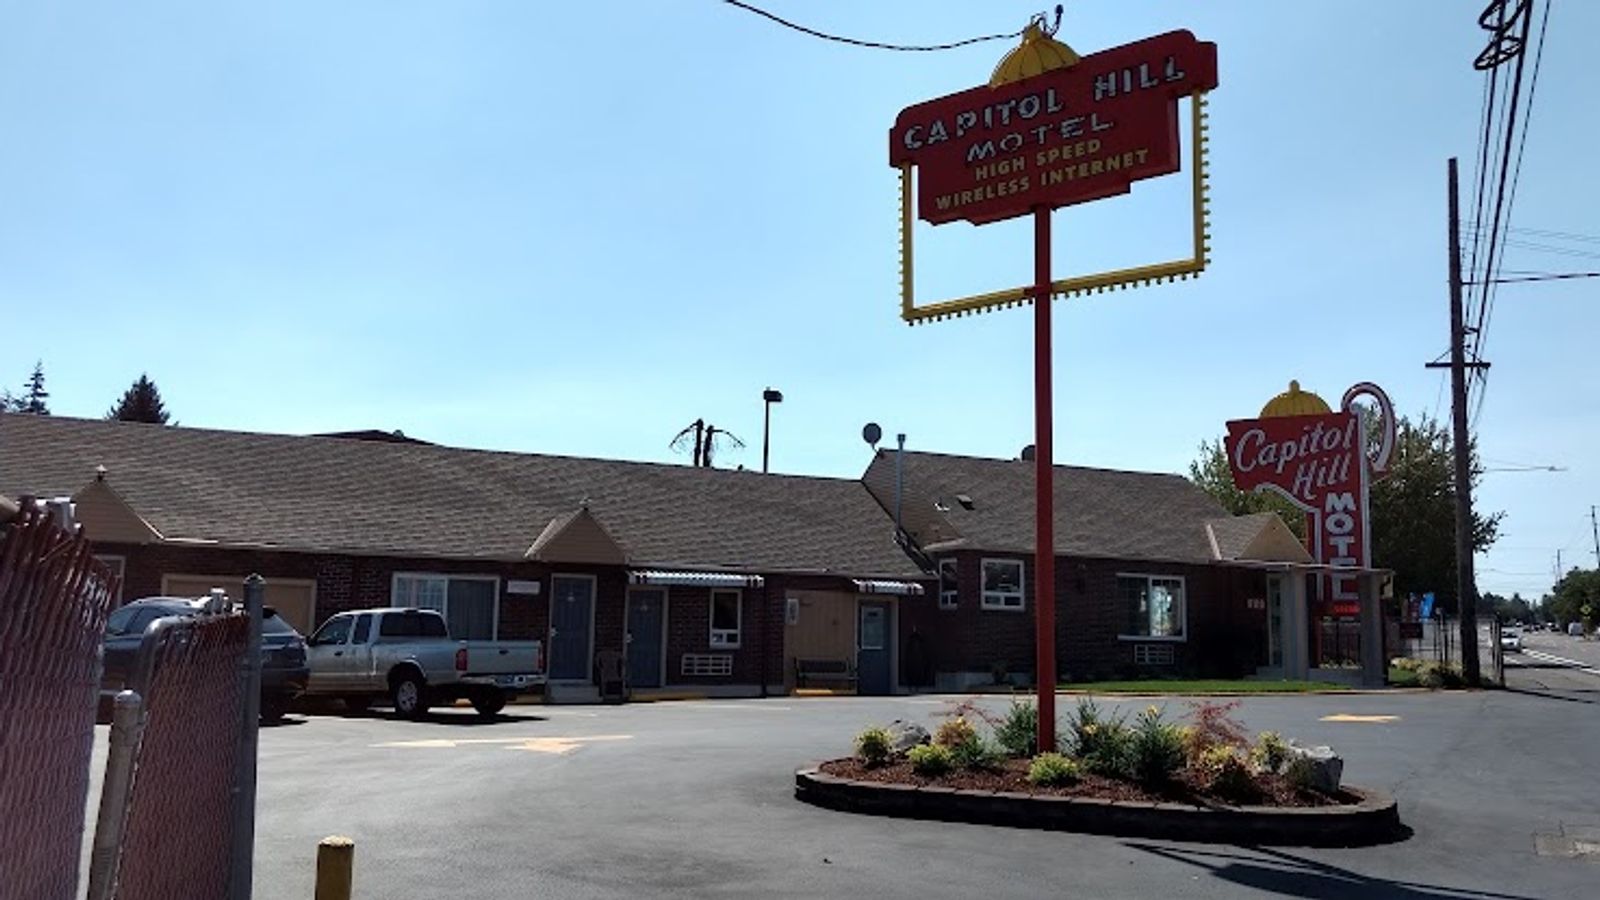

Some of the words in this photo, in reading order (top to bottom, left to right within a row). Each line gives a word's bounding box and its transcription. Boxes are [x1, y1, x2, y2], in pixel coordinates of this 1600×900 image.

[904, 89, 1063, 150] CAPITOL
[1094, 56, 1185, 101] HILL
[966, 113, 1114, 162] MOTEL
[975, 156, 1025, 181] HIGH
[1036, 139, 1101, 166] SPEED
[936, 176, 1030, 210] WIRELESS
[1041, 149, 1148, 186] INTERNET
[1234, 418, 1356, 474] Capitol
[1292, 452, 1351, 500] Hill
